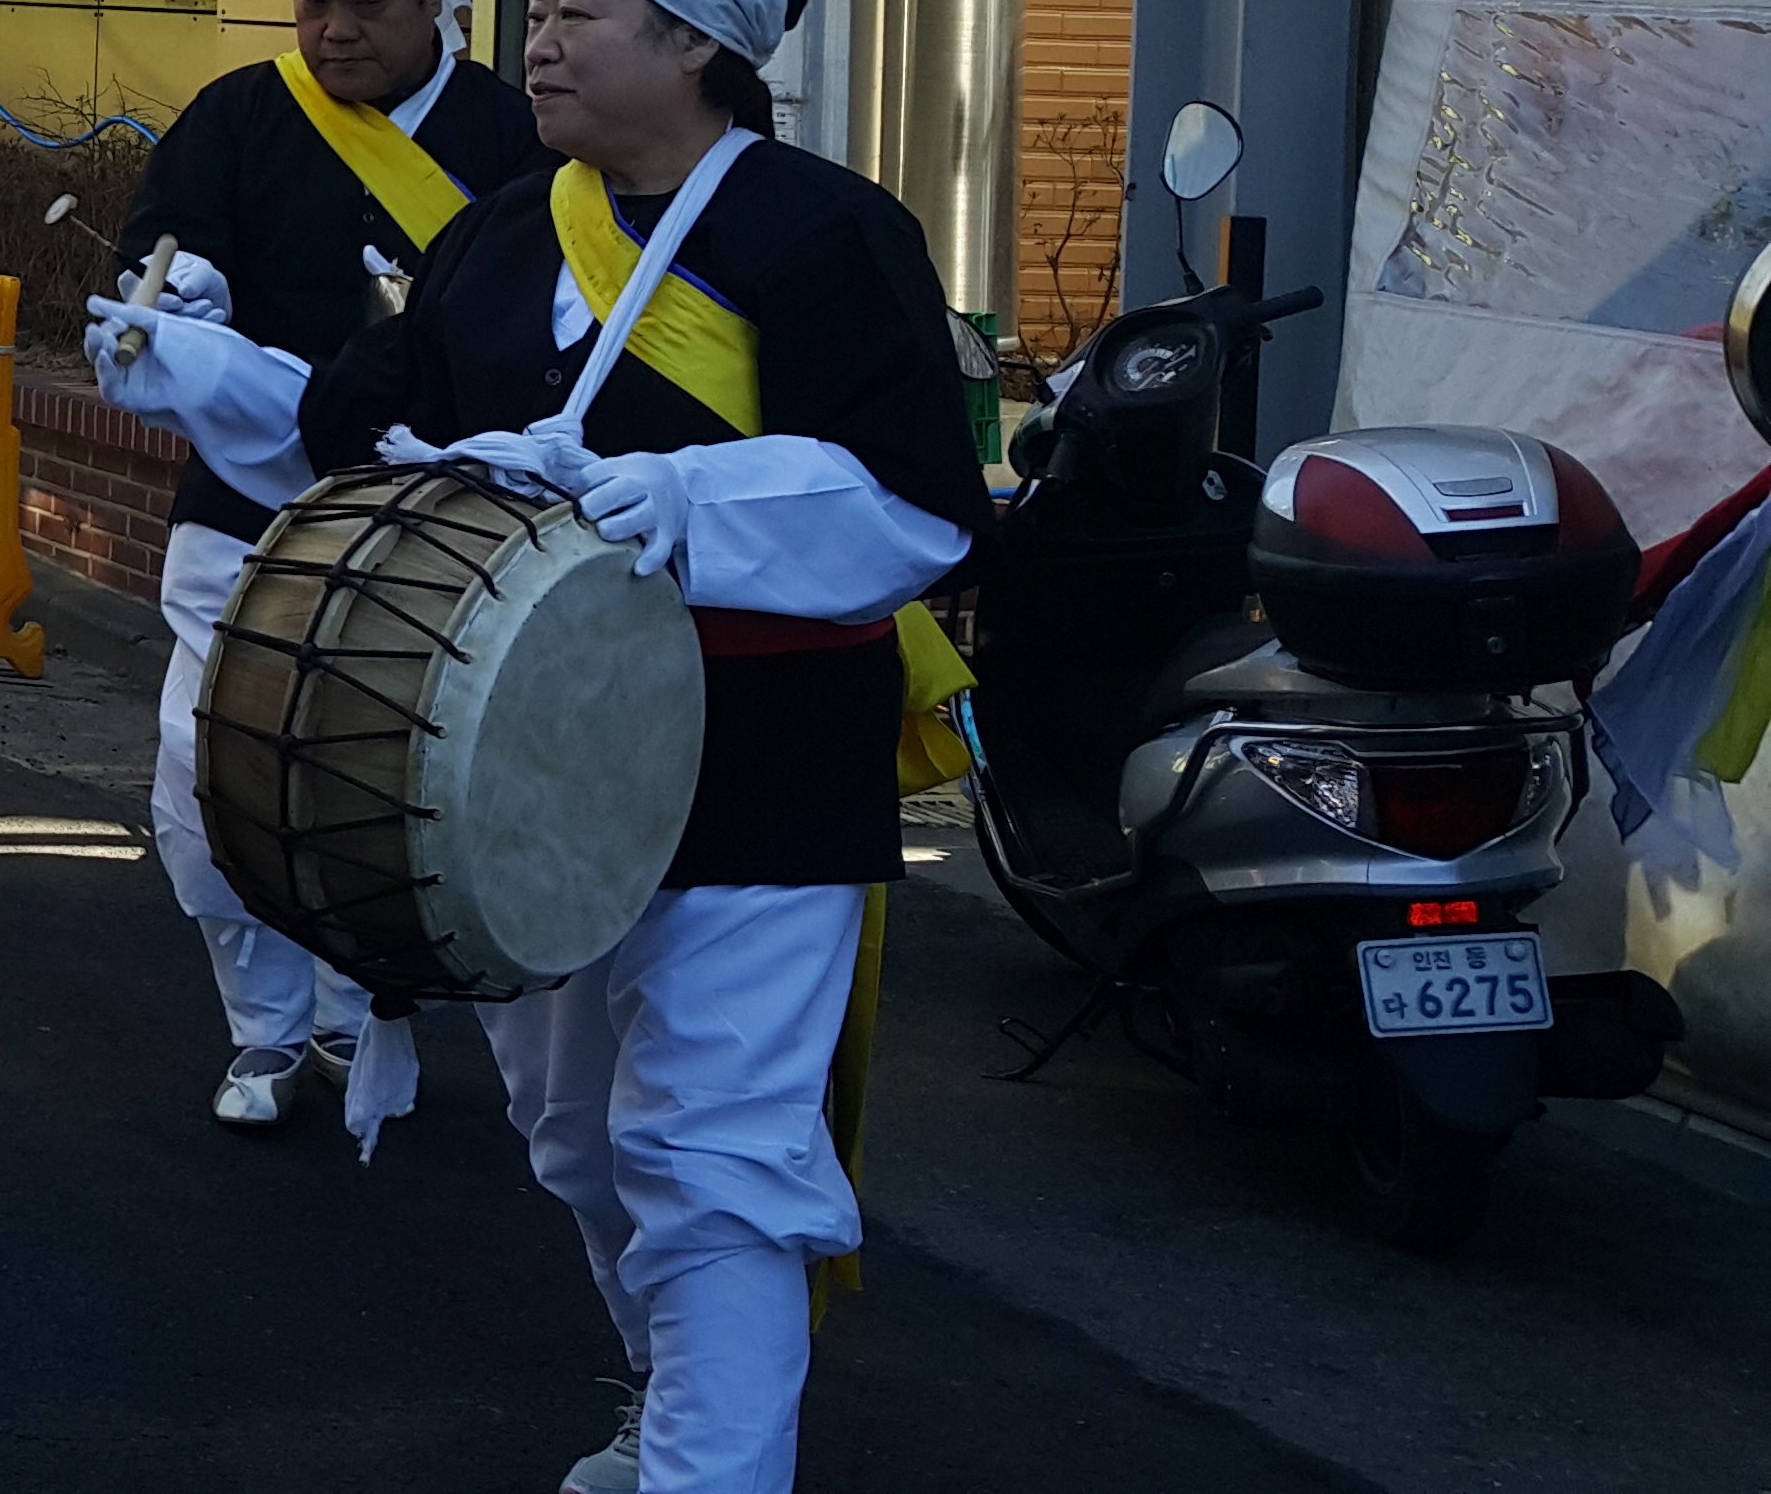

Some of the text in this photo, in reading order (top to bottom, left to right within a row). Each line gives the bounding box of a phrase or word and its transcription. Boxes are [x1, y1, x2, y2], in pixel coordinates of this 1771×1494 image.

[1412, 945, 1486, 972] 인천 동
[1417, 974, 1534, 1019] 6275
